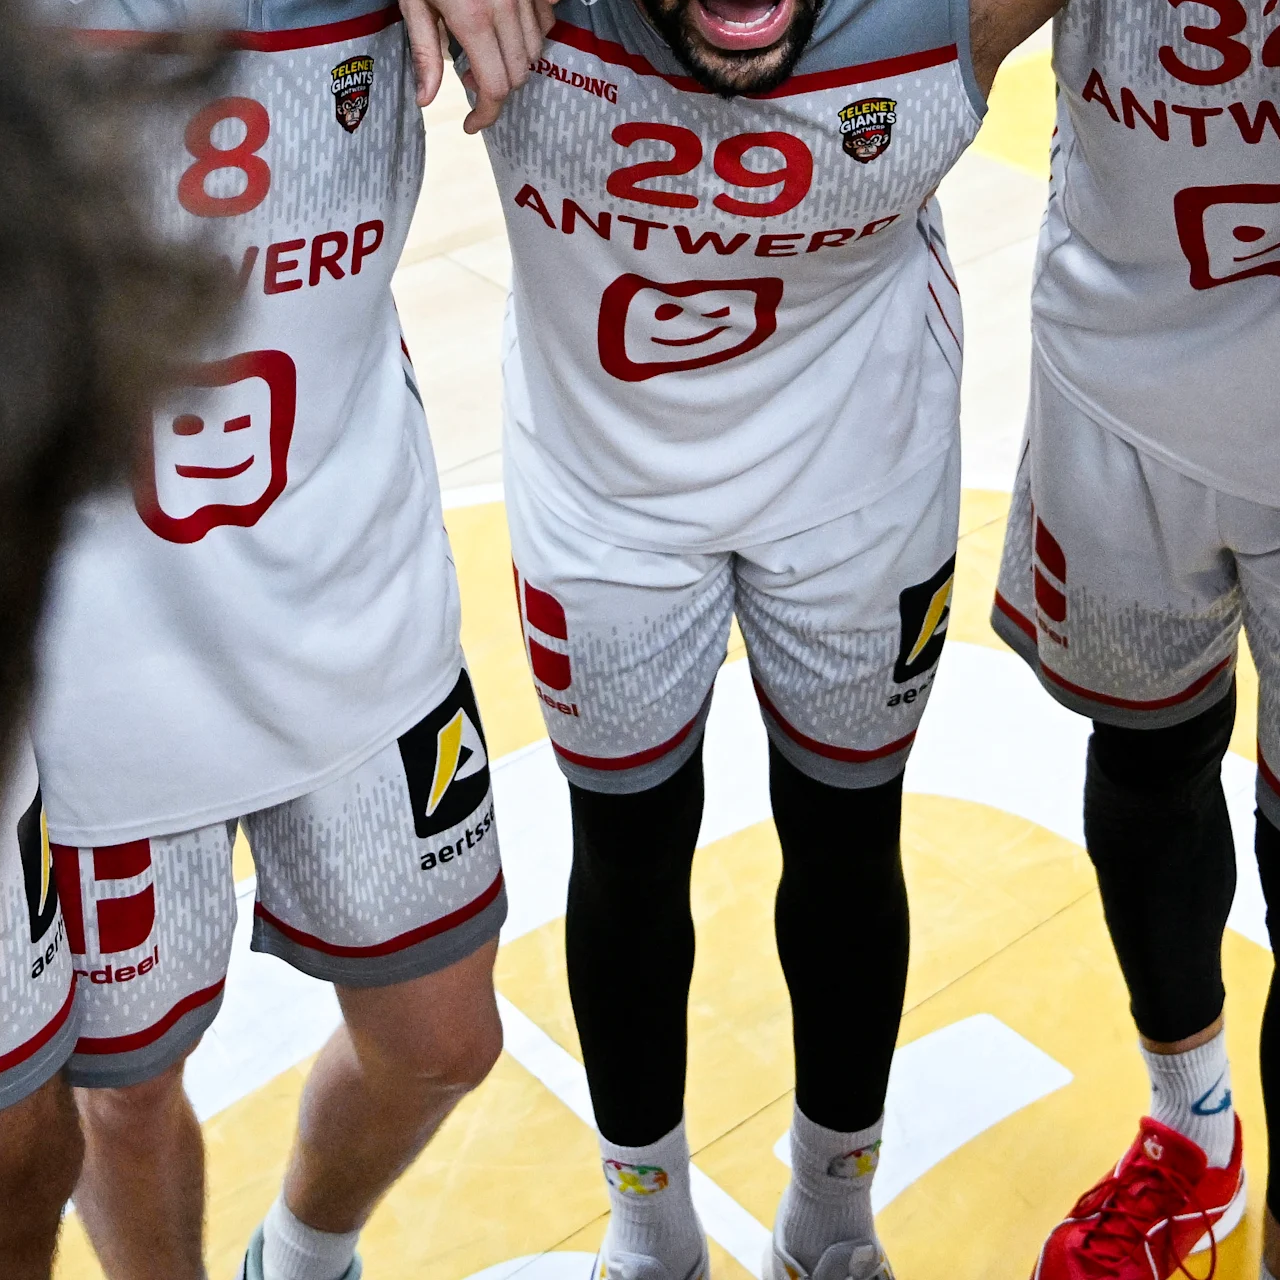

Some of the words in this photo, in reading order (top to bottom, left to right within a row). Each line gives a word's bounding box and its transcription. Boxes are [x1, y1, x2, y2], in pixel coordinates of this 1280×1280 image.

[332, 60, 374, 80] TELENET
[331, 71, 373, 94] GIANTS
[838, 101, 897, 122] TELENET
[840, 112, 897, 134] GIANTS
[851, 124, 886, 137] ANTWERP
[177, 96, 271, 219] 8
[606, 121, 813, 218] 29
